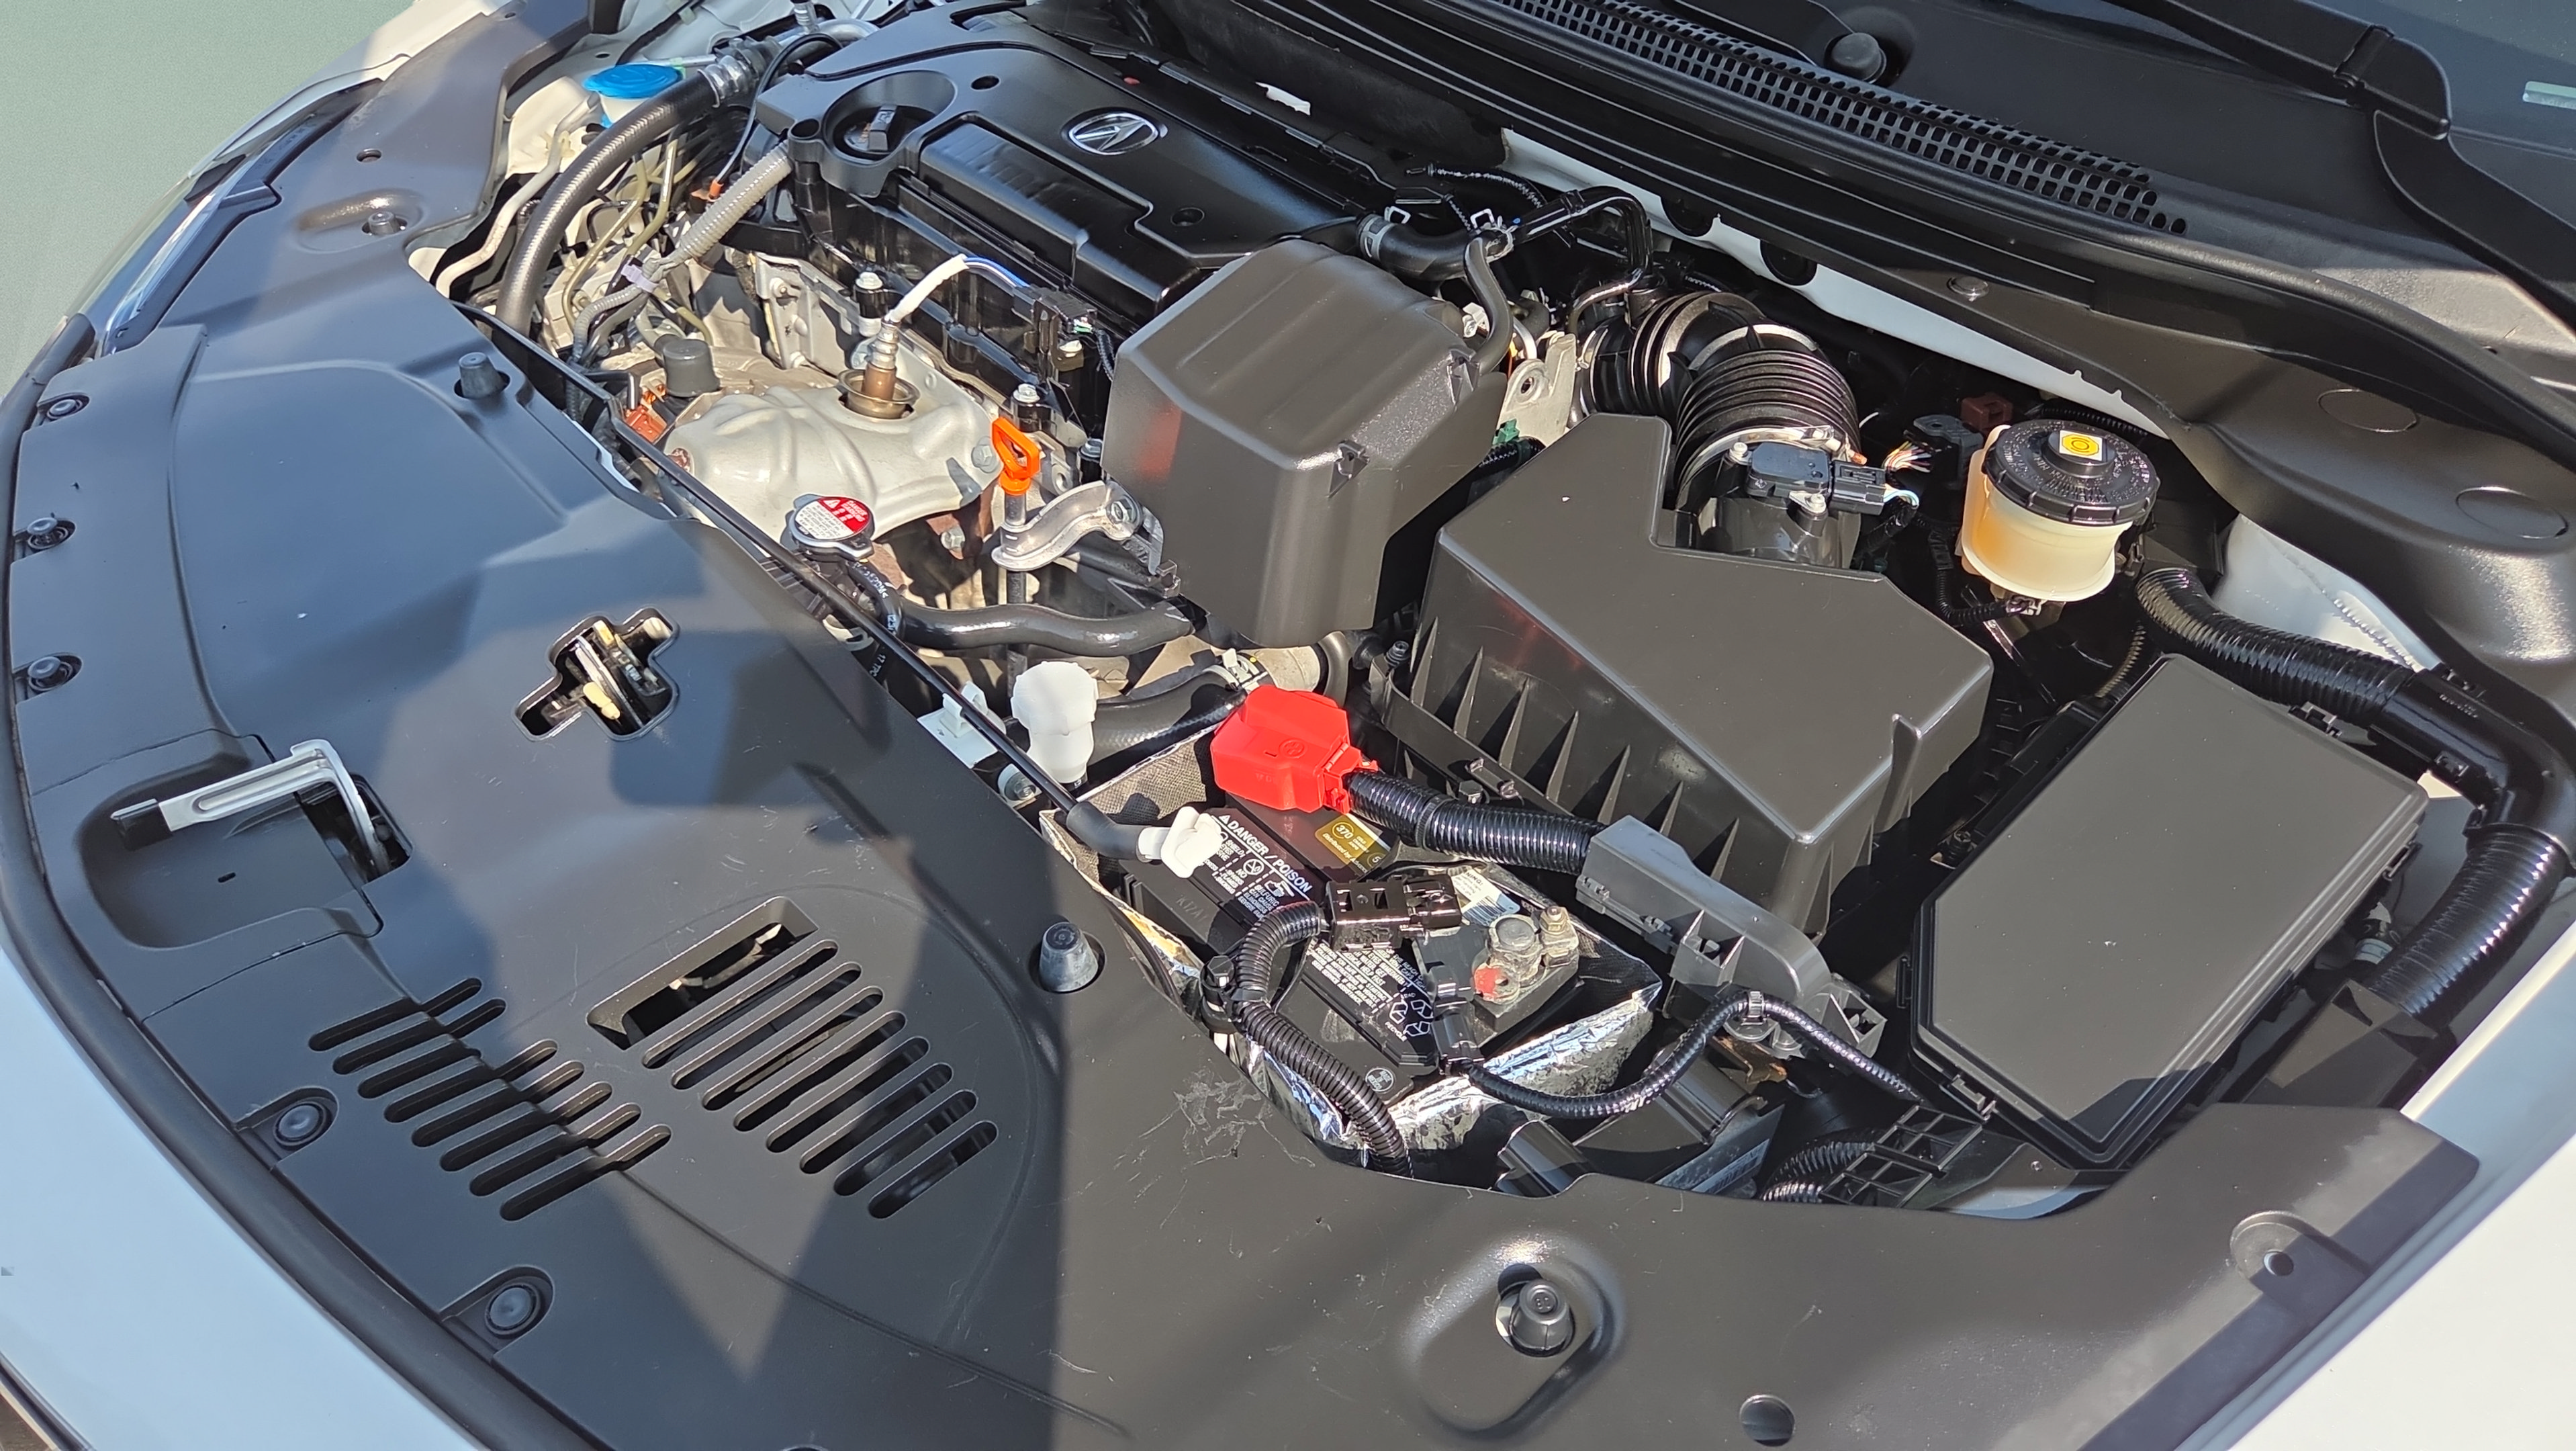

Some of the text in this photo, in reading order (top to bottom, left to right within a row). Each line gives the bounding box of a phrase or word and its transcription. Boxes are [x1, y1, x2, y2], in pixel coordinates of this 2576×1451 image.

[1336, 822, 1353, 838] 370
[1220, 843, 1234, 854] EYES
[1226, 840, 1244, 856] SHIELD
[1322, 833, 1346, 852] Distributed
[1228, 820, 1269, 854] DANGER
[1273, 859, 1312, 891] POISON
[1235, 869, 1247, 878] NO
[1254, 884, 1279, 906] SULFURIC
[1258, 897, 1273, 910] CAUSE
[1368, 953, 1381, 964] EYES
[1315, 947, 1332, 962] FOLLOW
[1330, 961, 1359, 985] INSTRUCTIONS
[1363, 988, 1380, 1003] VEHICLE
[1322, 969, 1339, 983] SERVICE
[1360, 965, 1374, 975] HELP
[1371, 973, 1385, 985] FAST
[1375, 968, 1387, 977] GET
[1389, 957, 1401, 969] VENT
[1399, 968, 1414, 979] CAPS
[1401, 961, 1418, 975] REACH
[1336, 957, 1346, 966] FOR
[1344, 965, 1356, 975] SAFE
[1365, 983, 1386, 1000] STARTING
[1346, 982, 1356, 990] NOT
[1354, 990, 1376, 1008] AVAILABLE
[1385, 1021, 1406, 1041] RECYCLE
